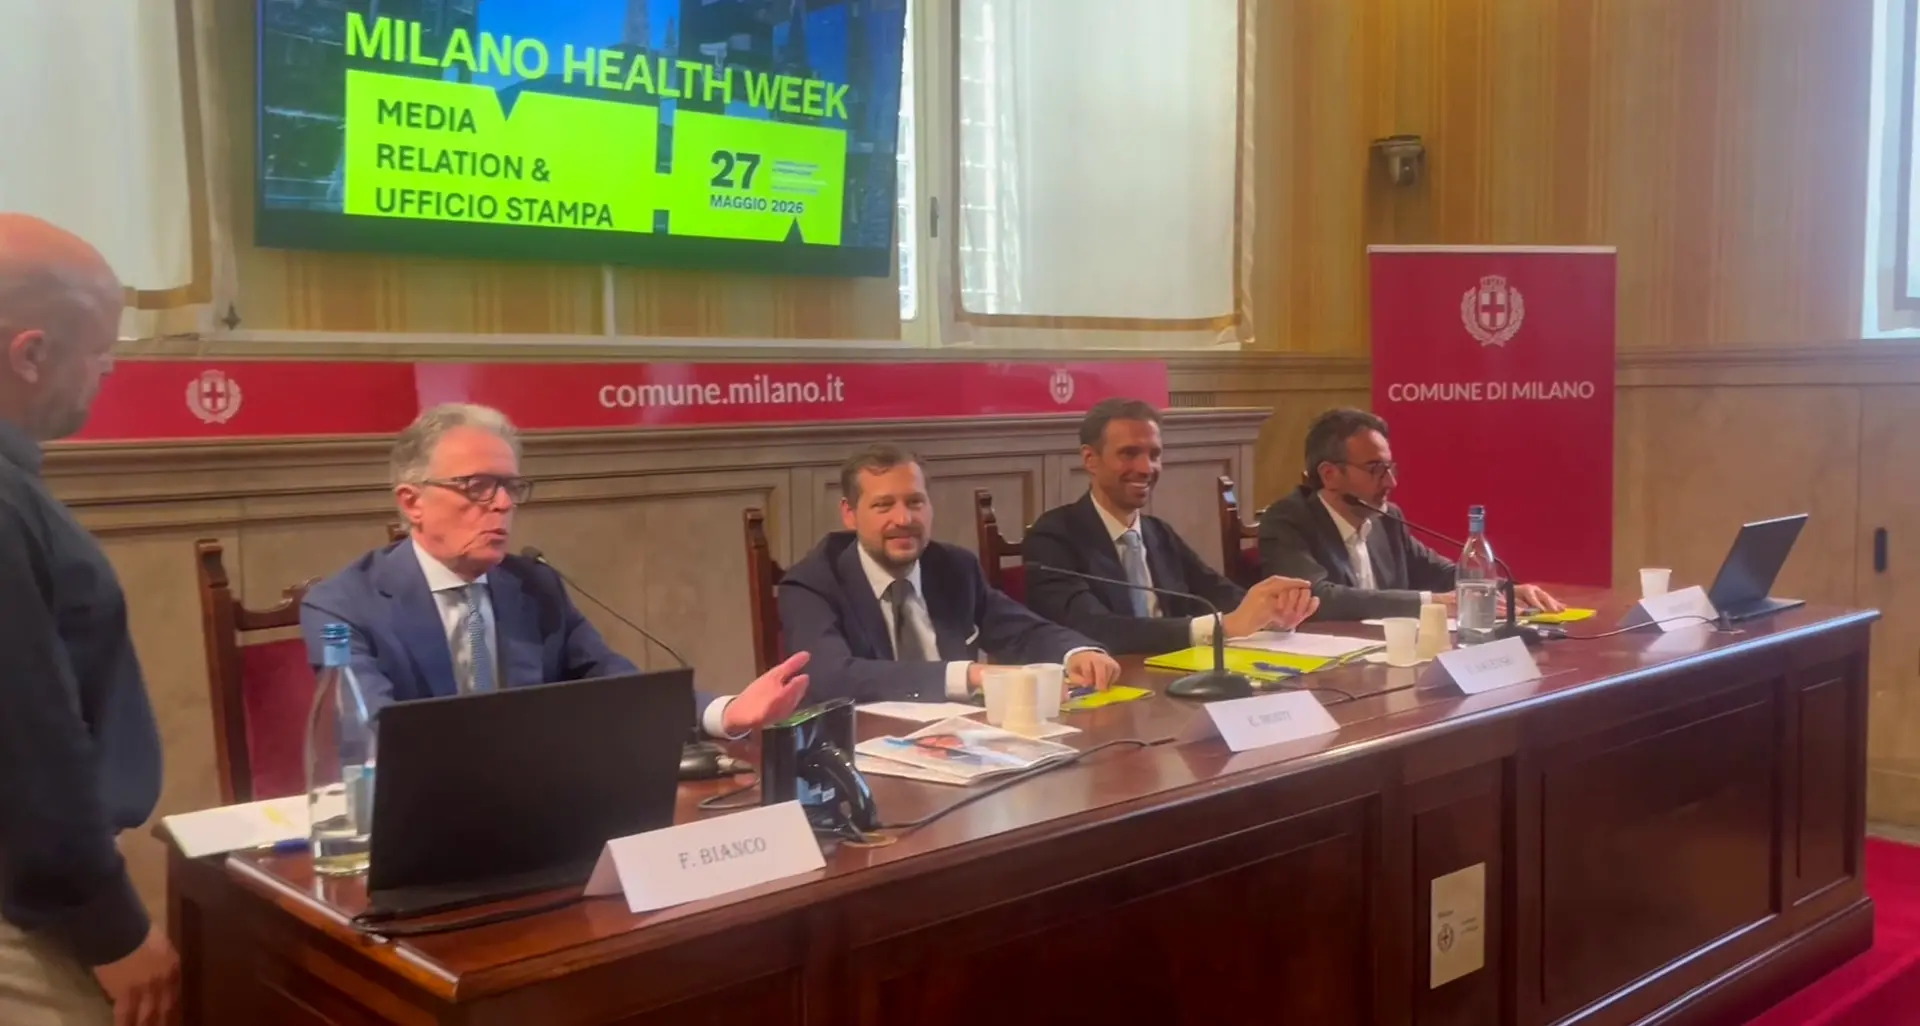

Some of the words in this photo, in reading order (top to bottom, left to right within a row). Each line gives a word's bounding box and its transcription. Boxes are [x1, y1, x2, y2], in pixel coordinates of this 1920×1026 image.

[346, 12, 549, 79] MILANO
[563, 44, 732, 104] HEALTH
[744, 70, 849, 119] WEEK
[378, 98, 476, 134] MEDIA
[376, 143, 523, 180] RELATION
[531, 157, 550, 182] &
[711, 150, 761, 189] 27
[376, 187, 498, 219] UFFICIO
[506, 197, 613, 228] STAMPA
[710, 194, 767, 211] MAGGIO
[772, 200, 804, 214] 2026
[599, 373, 844, 408] comune.milano.it
[1388, 382, 1482, 402] COMUNE
[1487, 382, 1507, 400] DI
[1512, 380, 1595, 400] MILANO
[678, 852, 696, 869] F.
[701, 837, 767, 865] BIANCO
